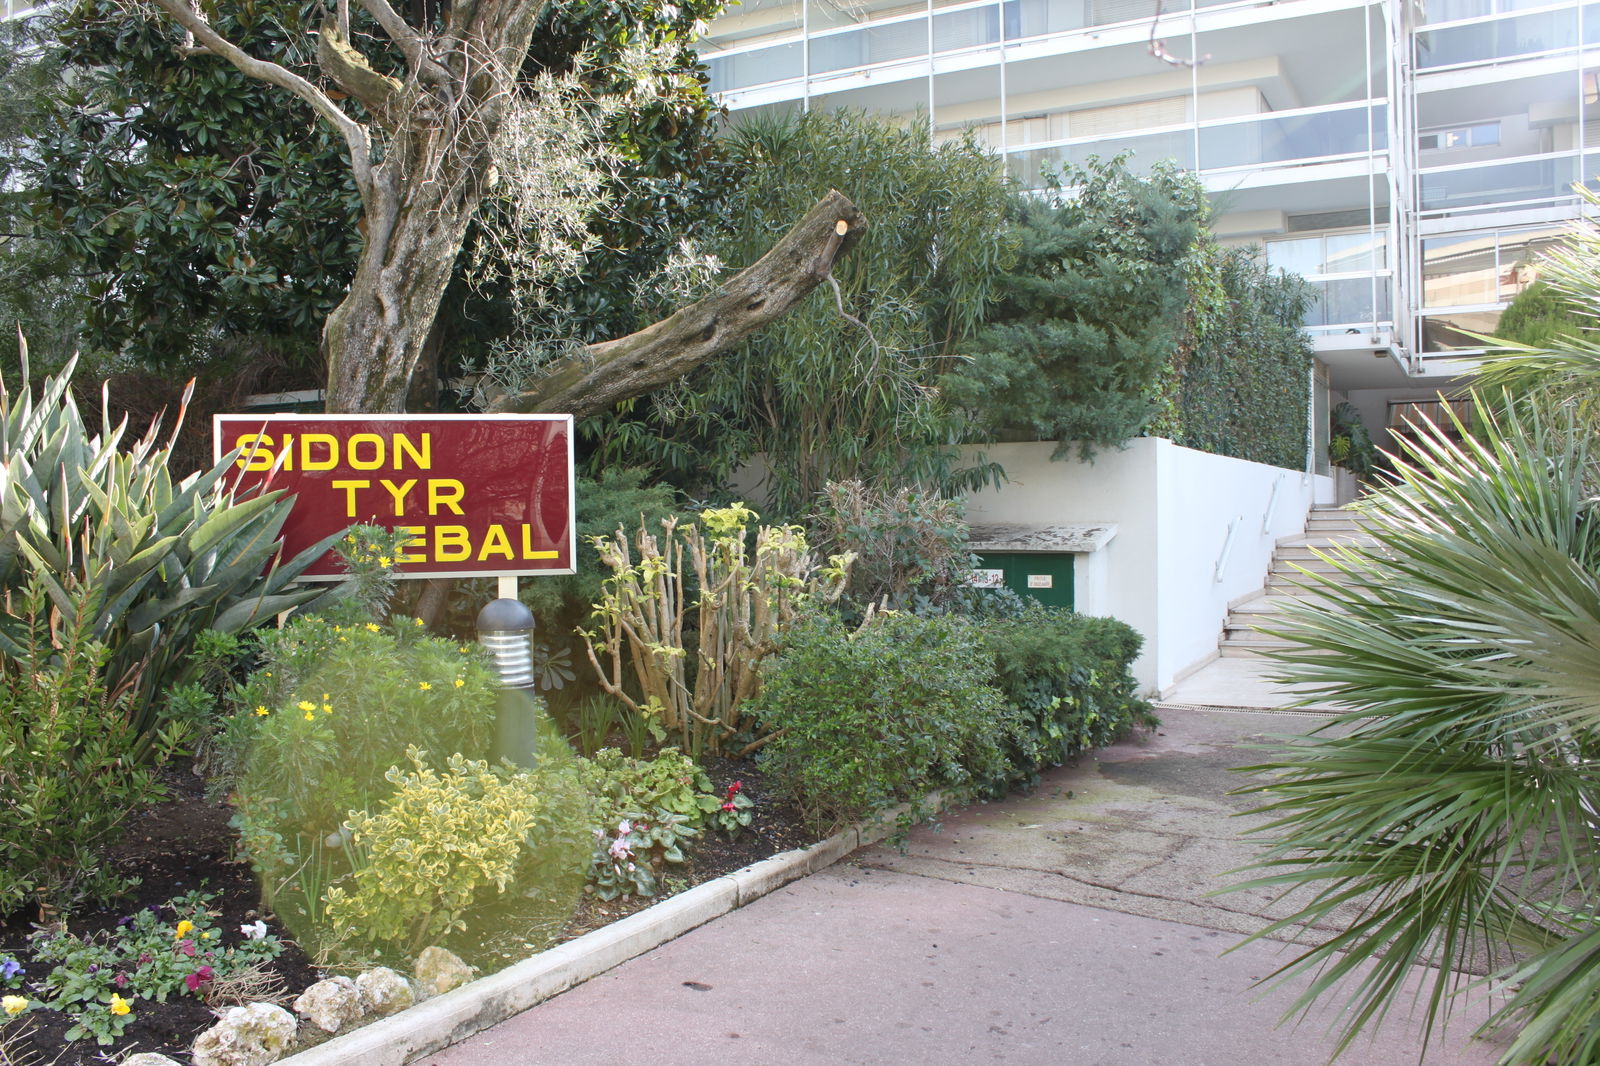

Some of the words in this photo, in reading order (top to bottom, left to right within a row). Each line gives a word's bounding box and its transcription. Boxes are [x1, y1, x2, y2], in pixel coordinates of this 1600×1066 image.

[235, 433, 431, 471] SIDON
[332, 479, 465, 517] TYR
[349, 523, 559, 563] EBAL
